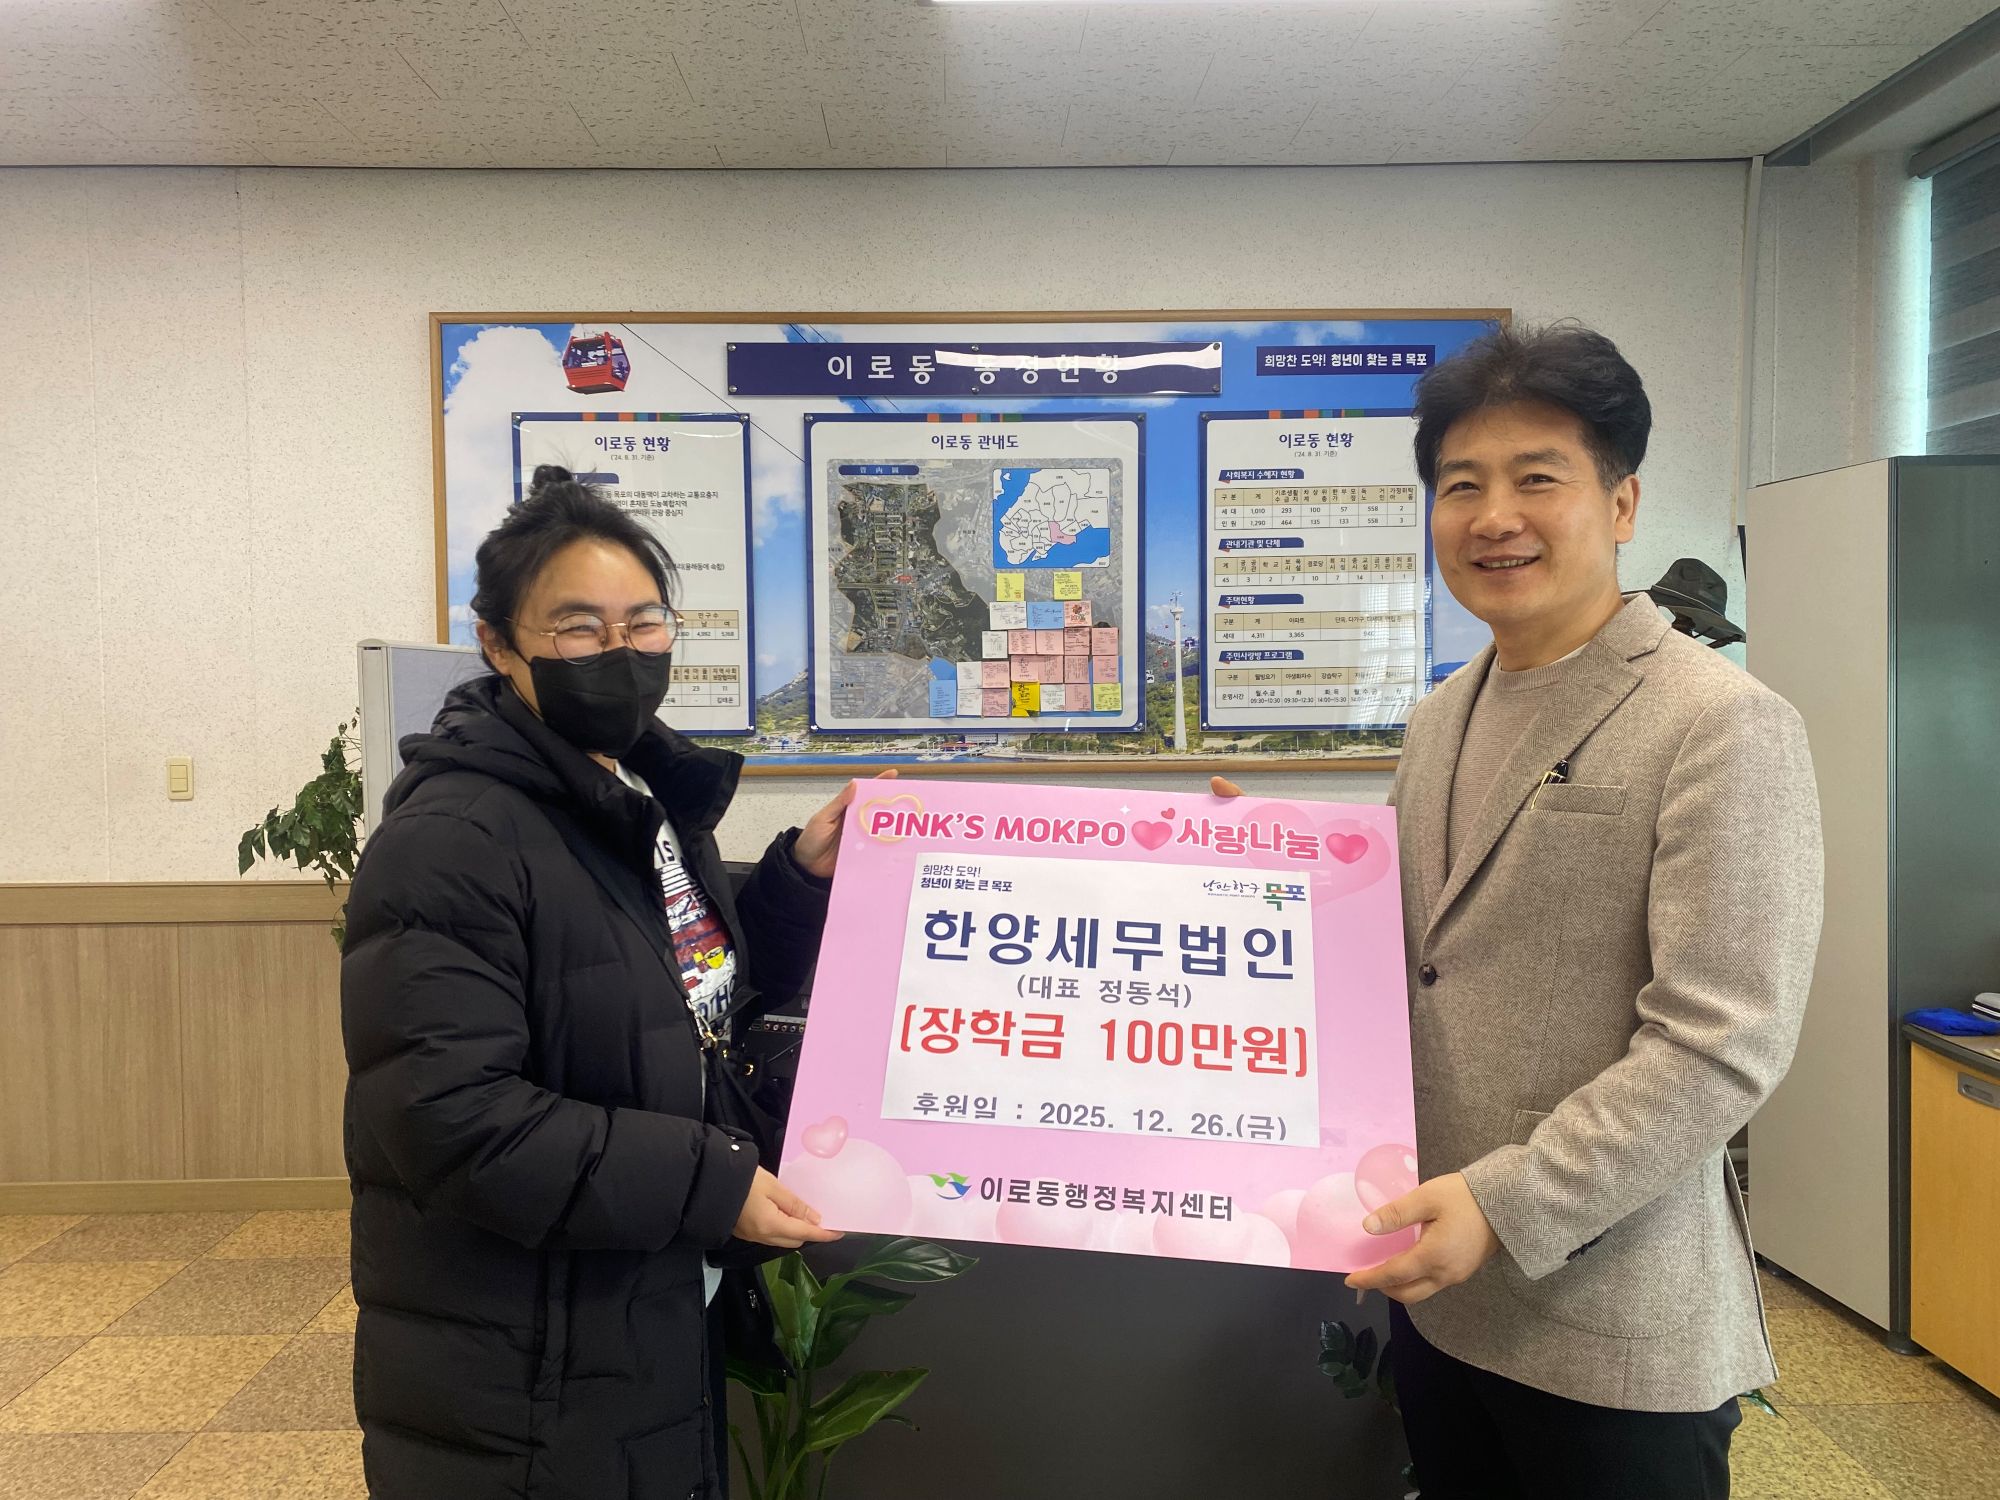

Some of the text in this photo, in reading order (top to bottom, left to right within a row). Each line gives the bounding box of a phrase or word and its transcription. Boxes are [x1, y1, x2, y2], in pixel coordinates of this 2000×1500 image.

[1264, 353, 1427, 368] 희망찬 도약! 청년이 찾는 큰 목포
[827, 355, 935, 385] 이로동
[594, 436, 671, 453] 이로동 현황
[931, 435, 1019, 450] 이로동 관내도
[1279, 432, 1354, 449] 이로동 현황
[1226, 470, 1295, 480] 사회복지 수혜자 현황
[1226, 539, 1281, 549] 관내기관 및 단체
[1225, 596, 1255, 605] 주택현황
[1226, 651, 1293, 661] 주민사랑방 프로그램
[870, 811, 1127, 848] PINK'S MOKPO
[1176, 818, 1322, 861] 사랑나눔
[922, 864, 981, 878] 희망찬 도약!
[920, 877, 1013, 892] 청년이 찾는 큰 목포
[1263, 883, 1306, 911] 목포
[924, 909, 1294, 981] 한양세무법인
[1016, 974, 1192, 1008] (대표 정동석)
[913, 1092, 998, 1121] 후원일
[1040, 1101, 1115, 1129] 2025.
[1133, 1109, 1173, 1133] 12.
[1190, 1112, 1288, 1142] 26.(금)
[980, 1176, 1234, 1222] 이로동행정복지센터
